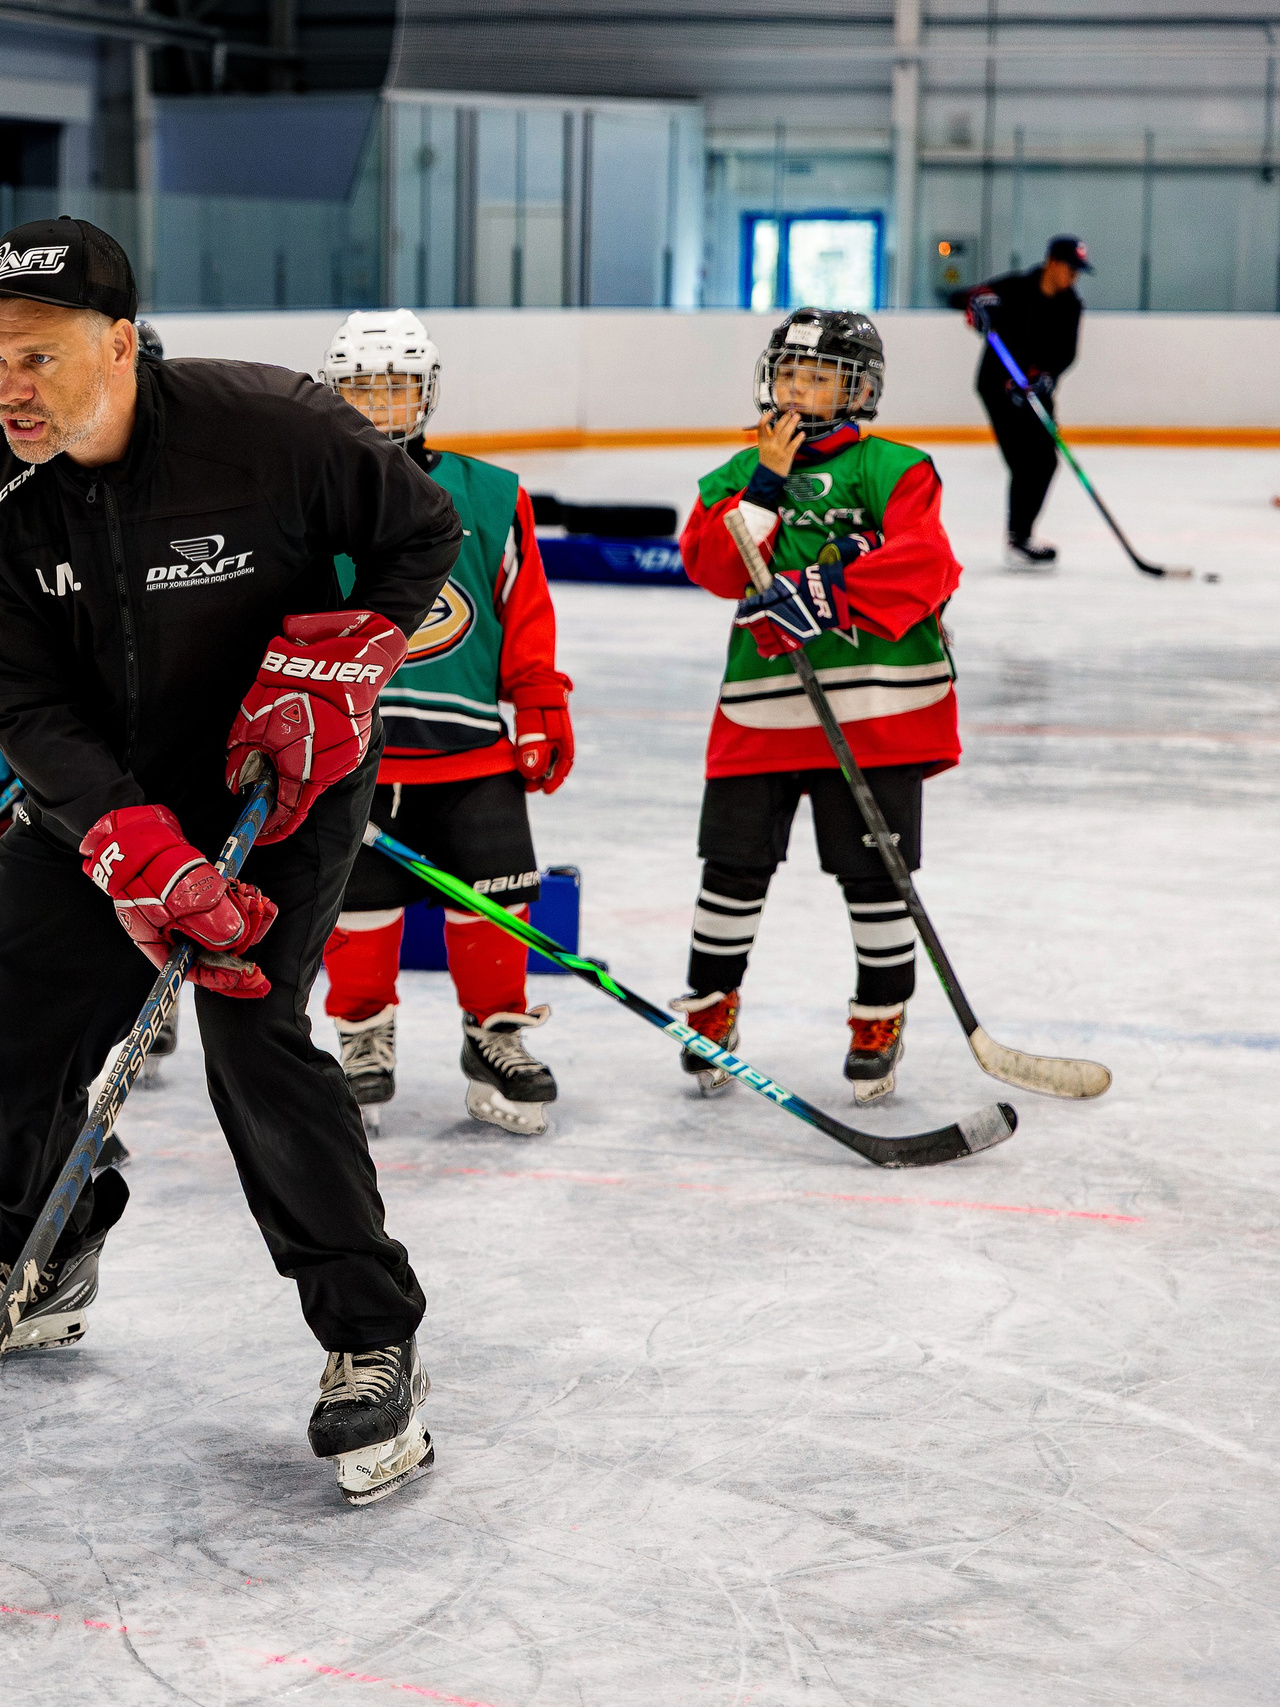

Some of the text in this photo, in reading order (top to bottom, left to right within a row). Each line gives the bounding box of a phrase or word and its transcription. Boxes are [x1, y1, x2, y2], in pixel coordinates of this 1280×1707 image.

[146, 550, 254, 582] DRAFT
[146, 566, 255, 592] ЦЕНТР ХОККЕЙНОЙ ПОДГОТОВКИ
[805, 563, 833, 620] UER
[261, 651, 384, 685] BAUER
[473, 870, 542, 894] BAUER
[97, 1020, 144, 1104] JETSPEED
[102, 969, 183, 1142] JETSPEED
[664, 1020, 792, 1106] BAUER
[355, 1464, 372, 1477] CCM
